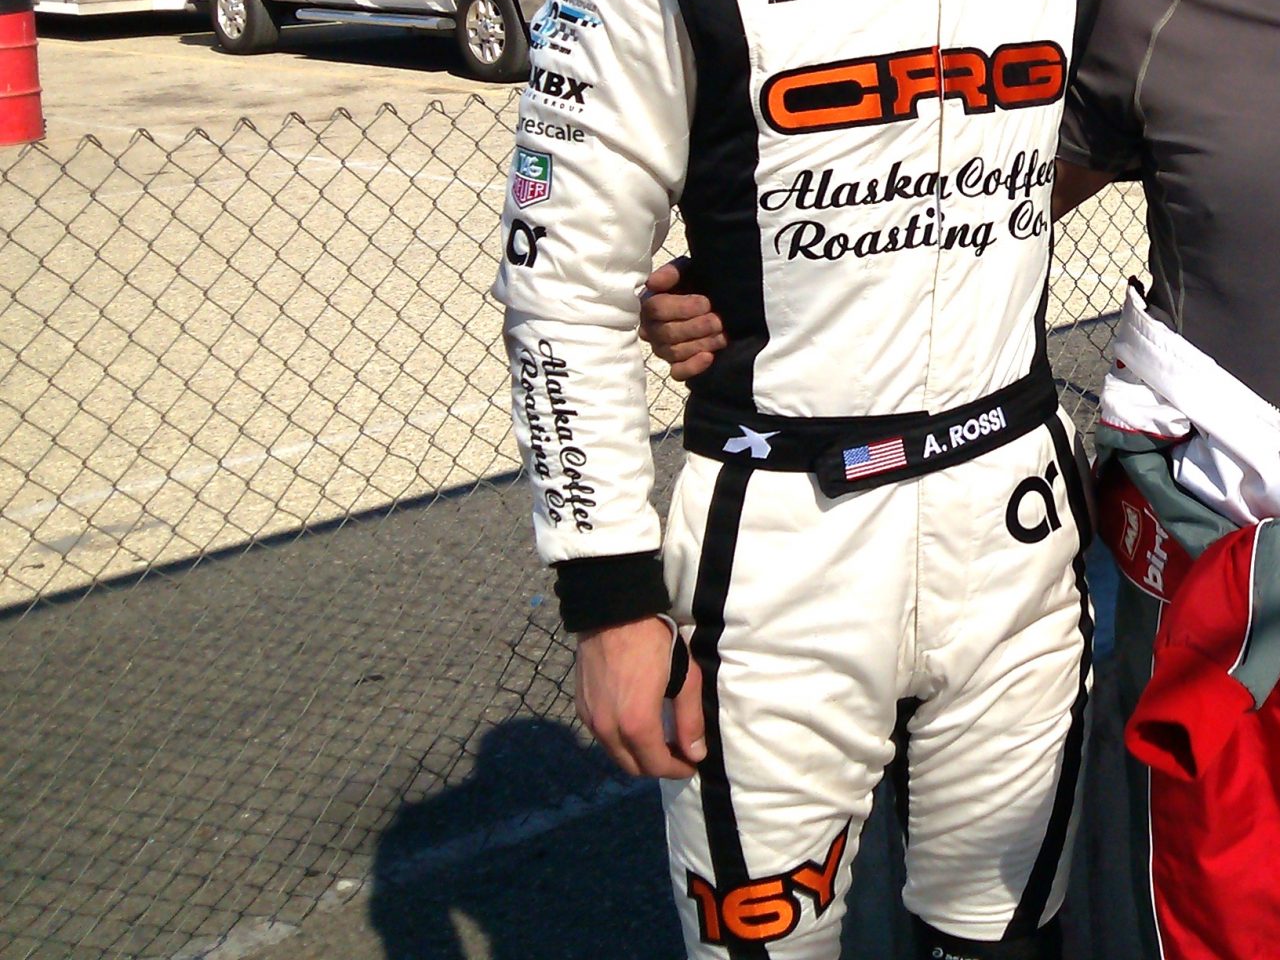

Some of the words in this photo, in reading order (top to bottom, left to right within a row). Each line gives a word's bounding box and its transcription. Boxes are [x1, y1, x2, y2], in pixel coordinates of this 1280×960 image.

[530, 66, 590, 106] KBX
[763, 41, 1066, 134] CRG
[515, 117, 585, 143] rescale
[759, 160, 952, 212] Alaska
[956, 148, 1056, 201] Coffee
[773, 207, 998, 261] Roasting
[538, 339, 579, 445] Alaska
[559, 446, 597, 535] Coffee
[922, 433, 948, 458] A.
[949, 406, 1007, 449] ROSSI
